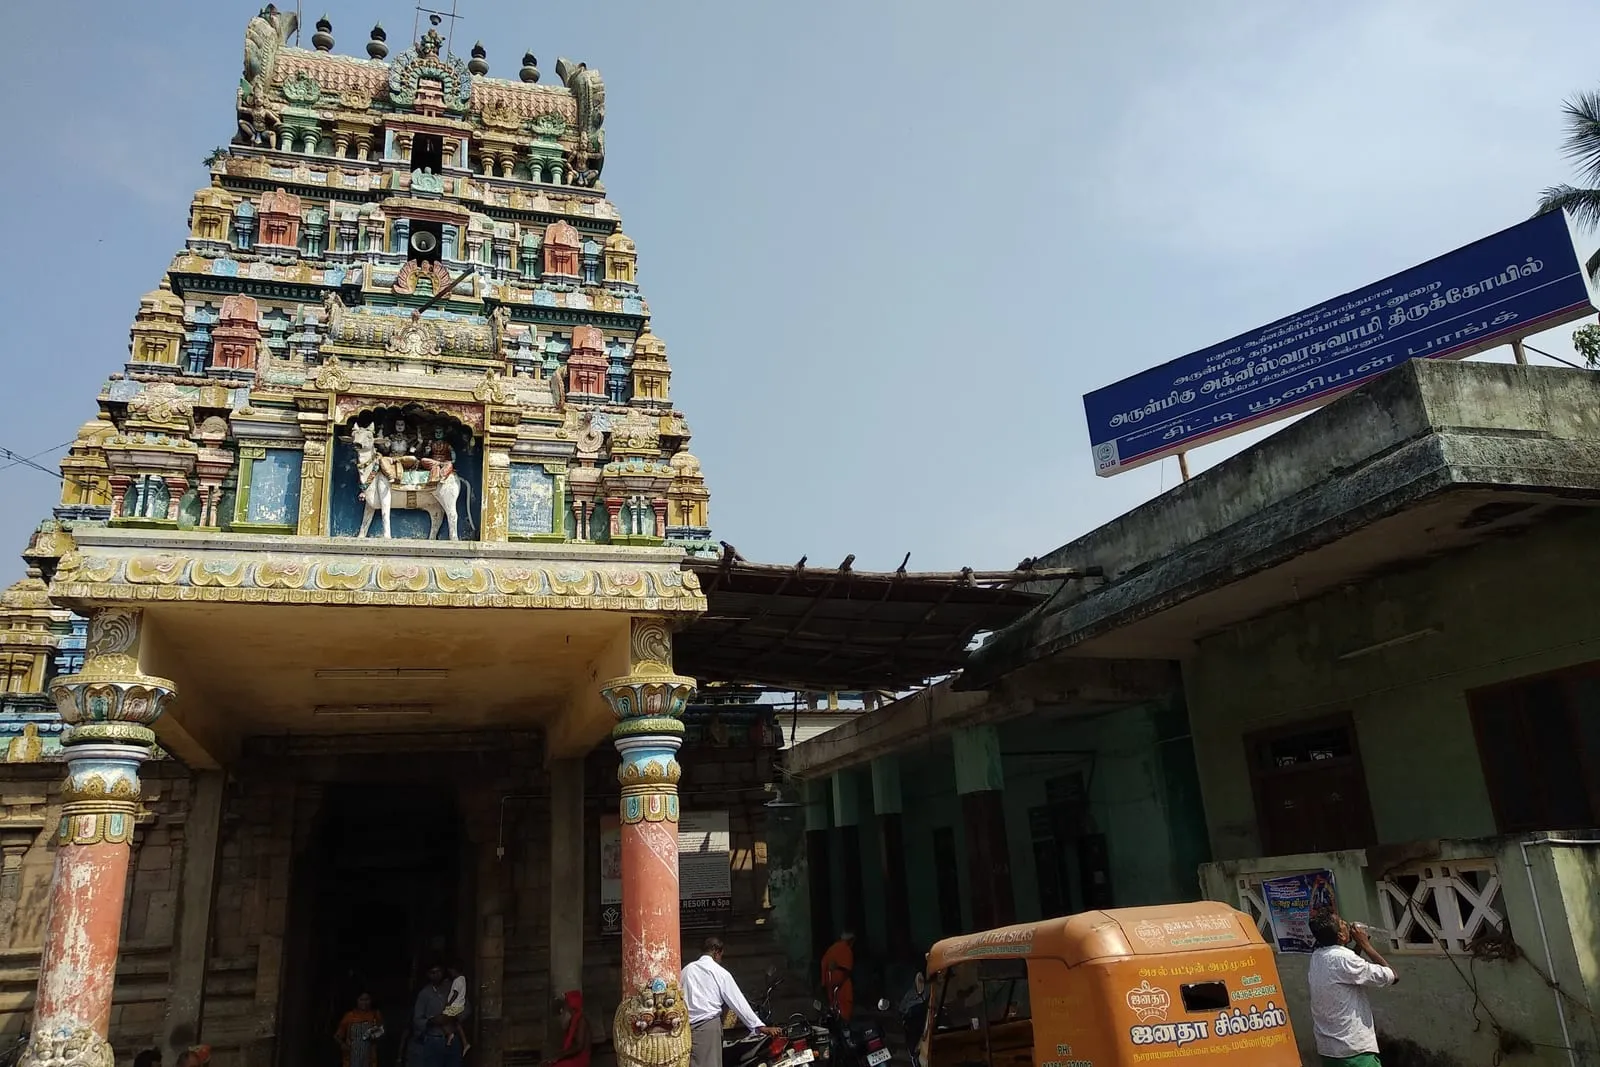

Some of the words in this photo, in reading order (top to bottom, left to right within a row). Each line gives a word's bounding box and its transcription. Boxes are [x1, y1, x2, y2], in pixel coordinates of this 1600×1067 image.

[1109, 388, 1196, 428] அருள்மிகு
[1199, 315, 1382, 394] அக்னீஸ்வரசுவாமி
[1387, 256, 1543, 331] திருக்கோயில்
[1172, 355, 1245, 386] அருள்மிகு
[1248, 313, 1355, 358] கற்பகாம்பாள்
[1359, 281, 1442, 316] உடனுறை
[1206, 345, 1241, 362] மதுரை
[1322, 287, 1393, 318] சொந்தமான
[1162, 412, 1238, 440] சிட்டி
[1248, 353, 1394, 413] யூனியன்
[1407, 310, 1519, 355] பாங்க்
[1099, 458, 1116, 470] CUB
[682, 899, 710, 909] RESORT
[717, 898, 731, 908] Spa
[1138, 965, 1168, 978] அசல்
[1207, 956, 1257, 973] அறிமுகம்
[1130, 993, 1166, 1007] ஜனதா
[1130, 1021, 1209, 1047] ஜனதா
[1214, 1002, 1288, 1037] சில்க்ஸ்
